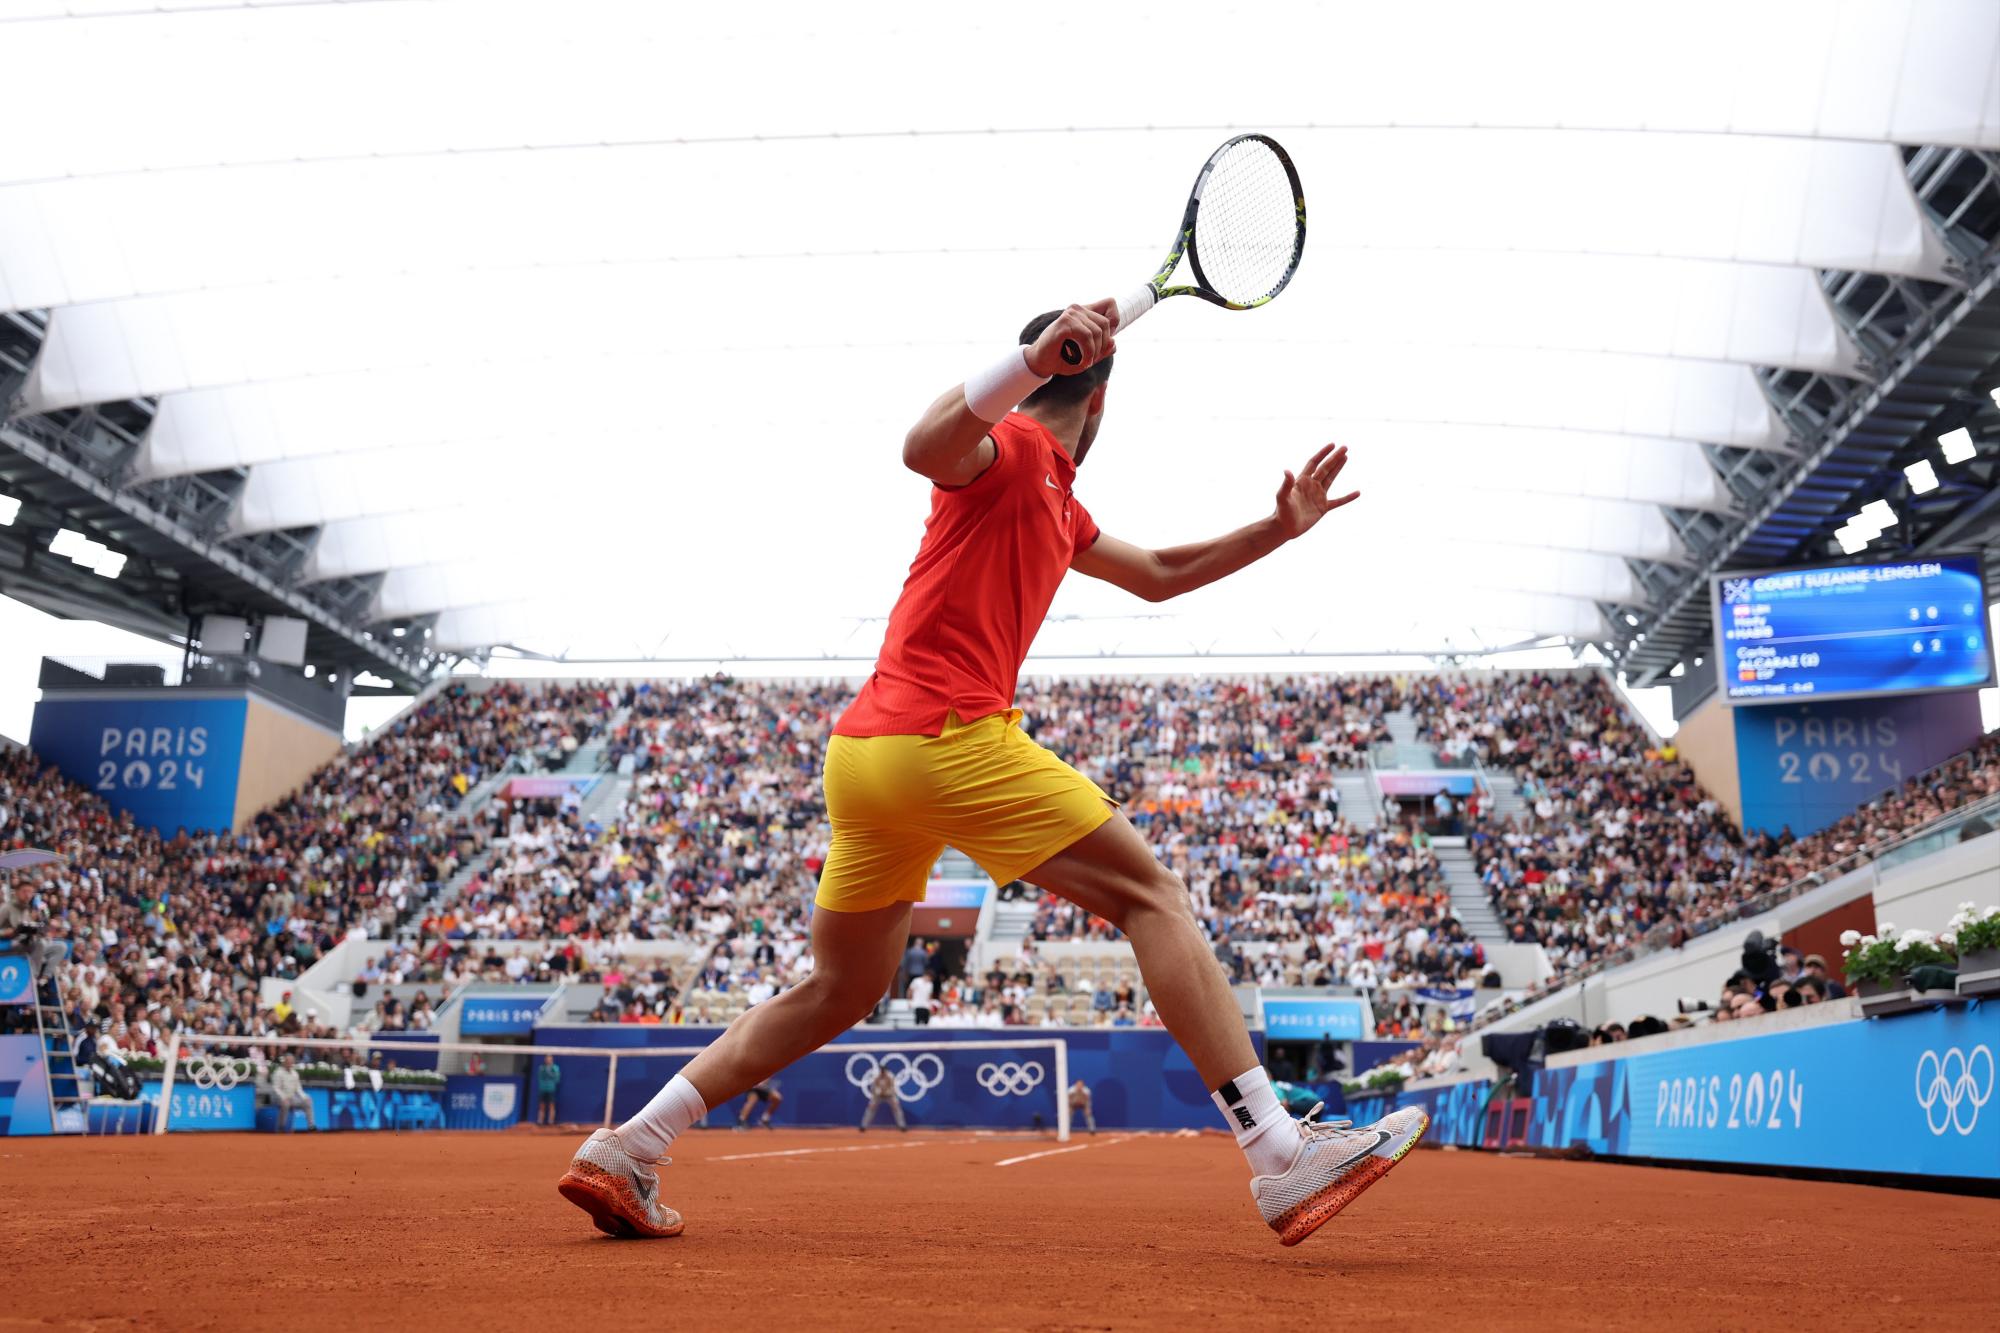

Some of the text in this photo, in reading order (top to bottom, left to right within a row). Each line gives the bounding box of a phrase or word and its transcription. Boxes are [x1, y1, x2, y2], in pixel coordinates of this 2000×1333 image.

[97, 760, 205, 790] 2024
[1779, 751, 1902, 784] 2024
[187, 1094, 233, 1118] 2024
[1727, 1068, 1803, 1129] 2024
[1232, 1105, 1257, 1130] NIKE
